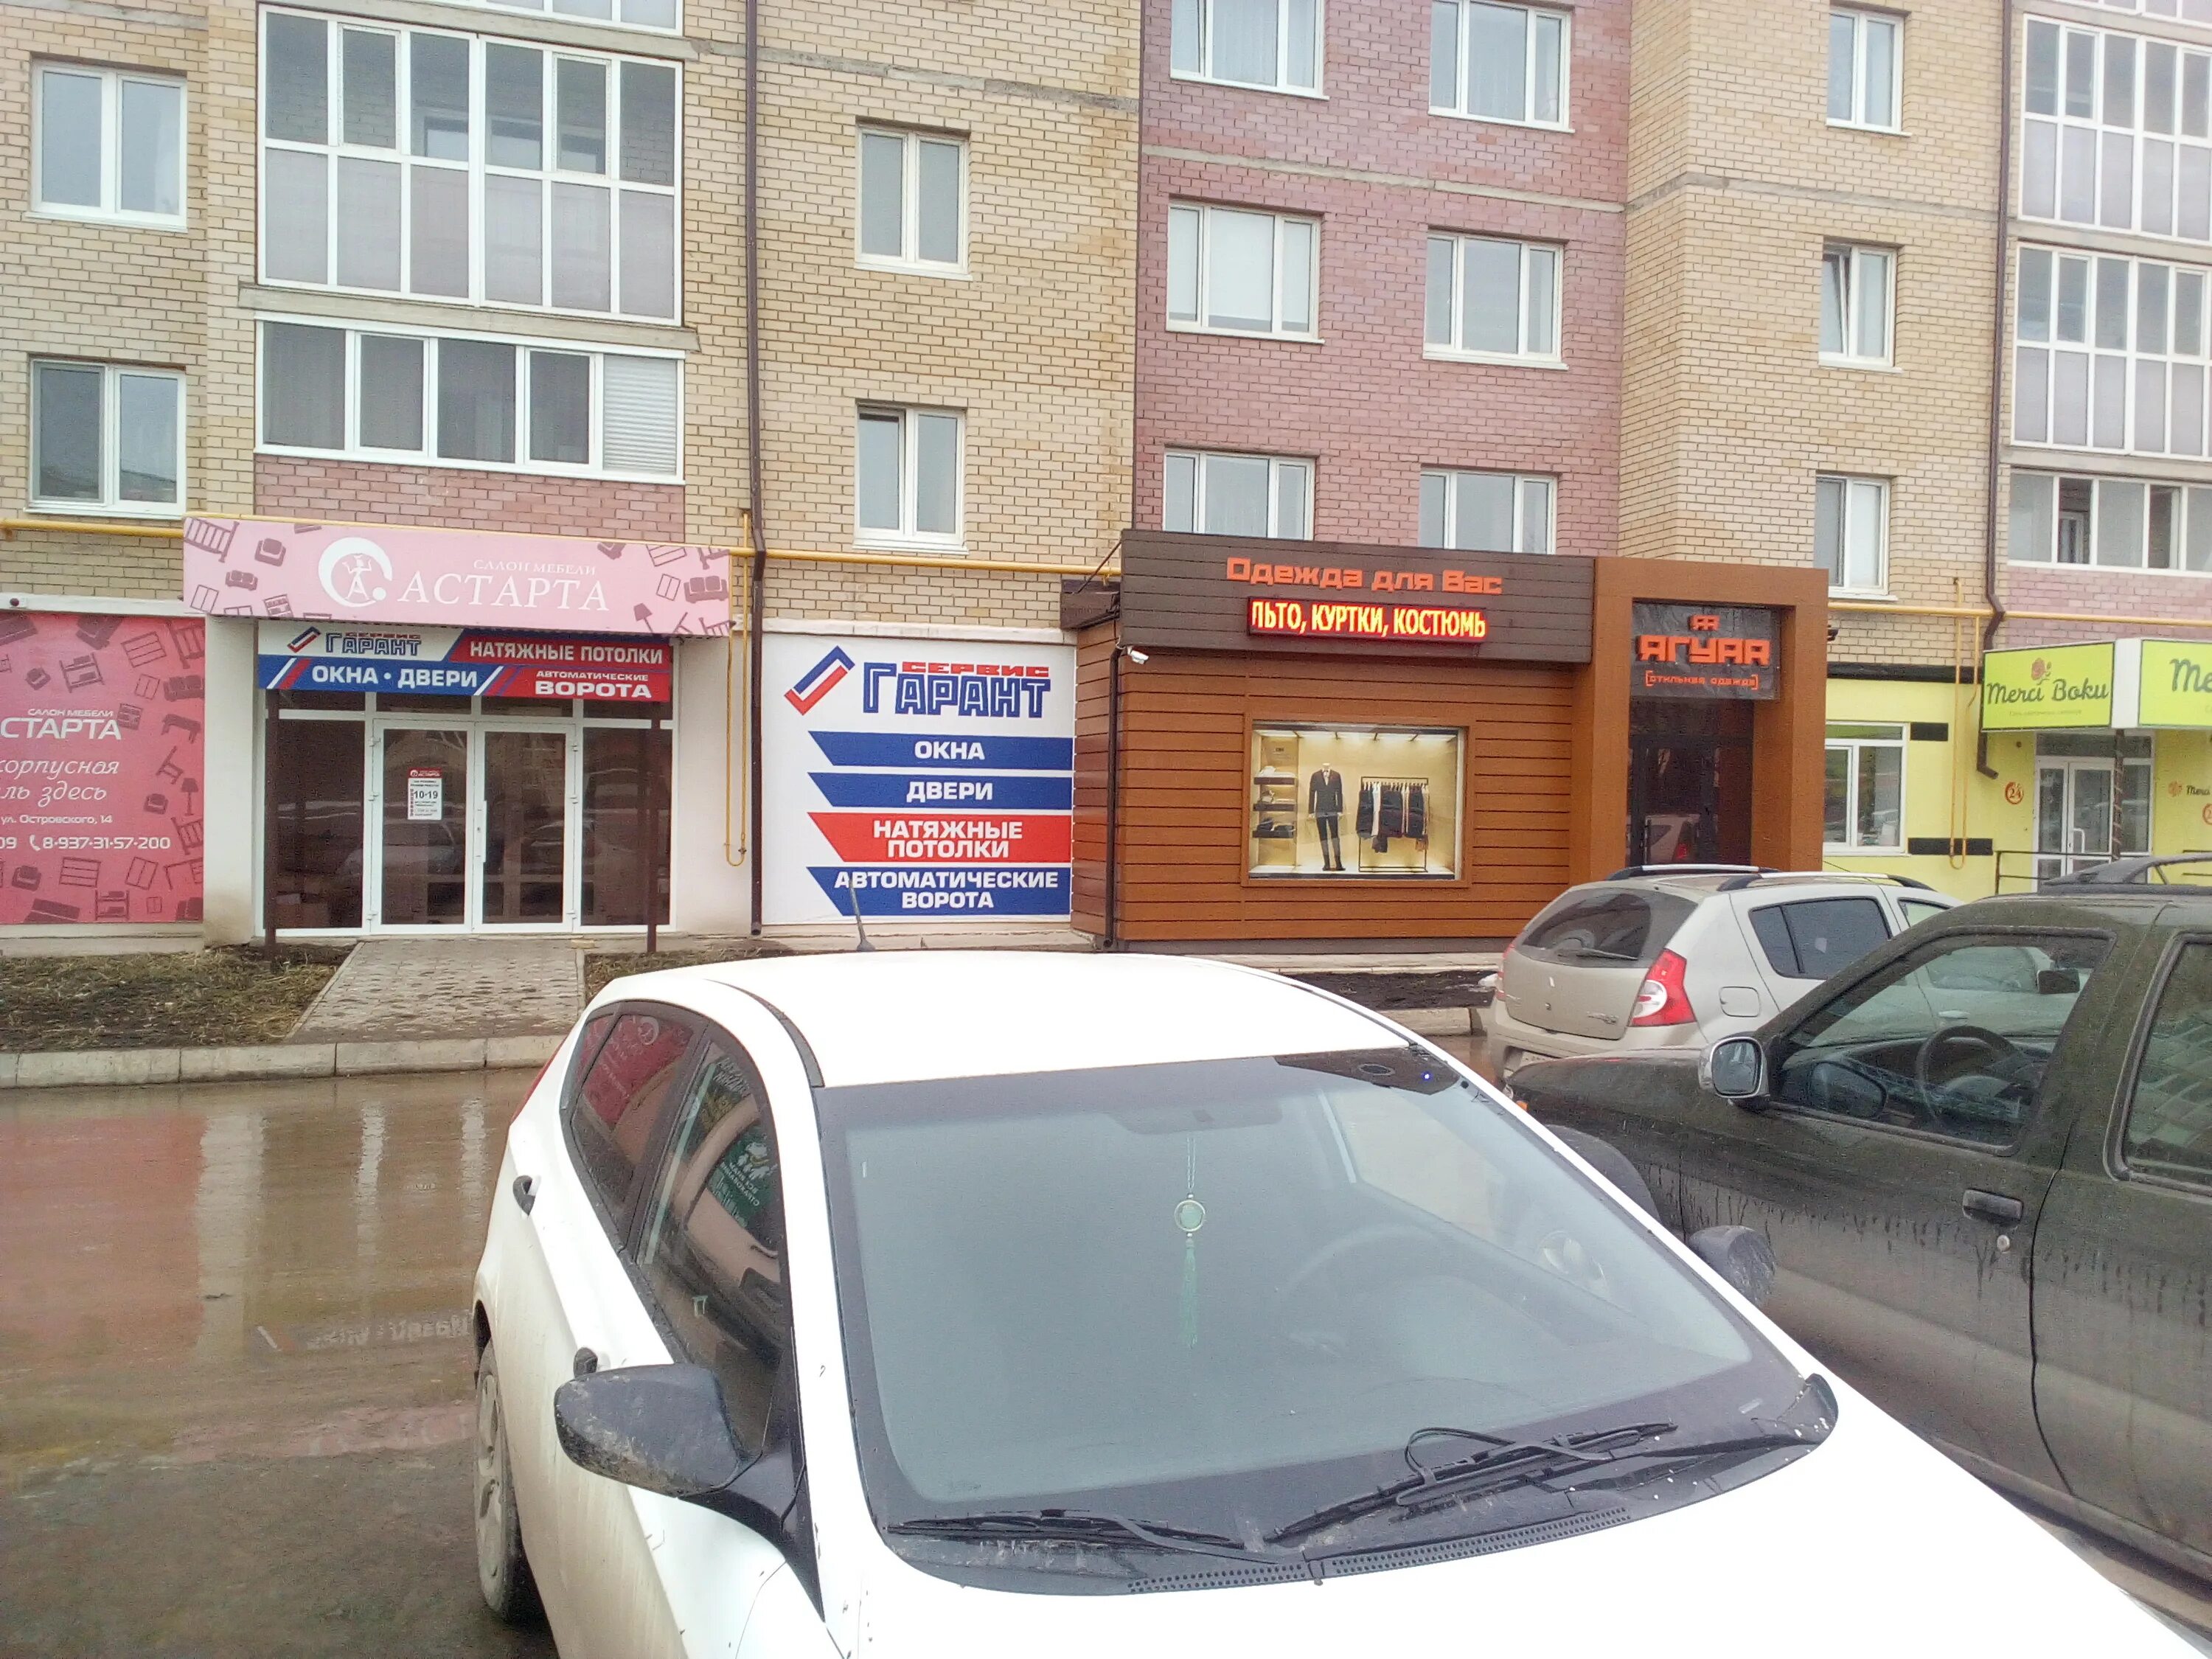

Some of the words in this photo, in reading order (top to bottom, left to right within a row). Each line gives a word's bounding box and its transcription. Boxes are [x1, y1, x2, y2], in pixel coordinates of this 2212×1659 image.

[473, 559, 530, 572] САЛОН
[533, 563, 595, 576] МЕБЕЛИ
[1226, 557, 1363, 590] Одежда
[1371, 568, 1434, 592] для
[1442, 569, 1503, 594] Вас
[397, 570, 610, 611] АСТАРТА
[1311, 604, 1389, 638] КУРТКИ,
[470, 641, 574, 661] НАТЯЖНЫЕ
[580, 646, 663, 664] ПОТОЛКИ
[311, 665, 379, 684] ОКНА
[397, 668, 478, 689] ДВЕРИ
[535, 670, 649, 681] АВТОМАТИЧЕСКИЕ
[902, 661, 1050, 678] СЕРВИС
[535, 681, 653, 698] ВОРОТА
[863, 661, 1051, 718] ГАРАНТ
[1986, 681, 2045, 705] Merci
[2051, 677, 2110, 701] Boku
[28, 708, 66, 716] САЛОН
[67, 709, 114, 717] МЕБЕЛИ
[914, 740, 986, 760] ОКНА
[38, 781, 108, 807] здесь
[906, 781, 993, 803] ДВЕРИ
[19, 814, 98, 825] Островского,
[100, 815, 113, 824] 14
[872, 819, 1023, 840] НАТЯЖНЫЕ
[888, 840, 1009, 858] ПОТОЛКИ
[834, 871, 1059, 889] АВТОМАТИЧЕСКИЕ
[902, 891, 995, 909] ВОРОТА
